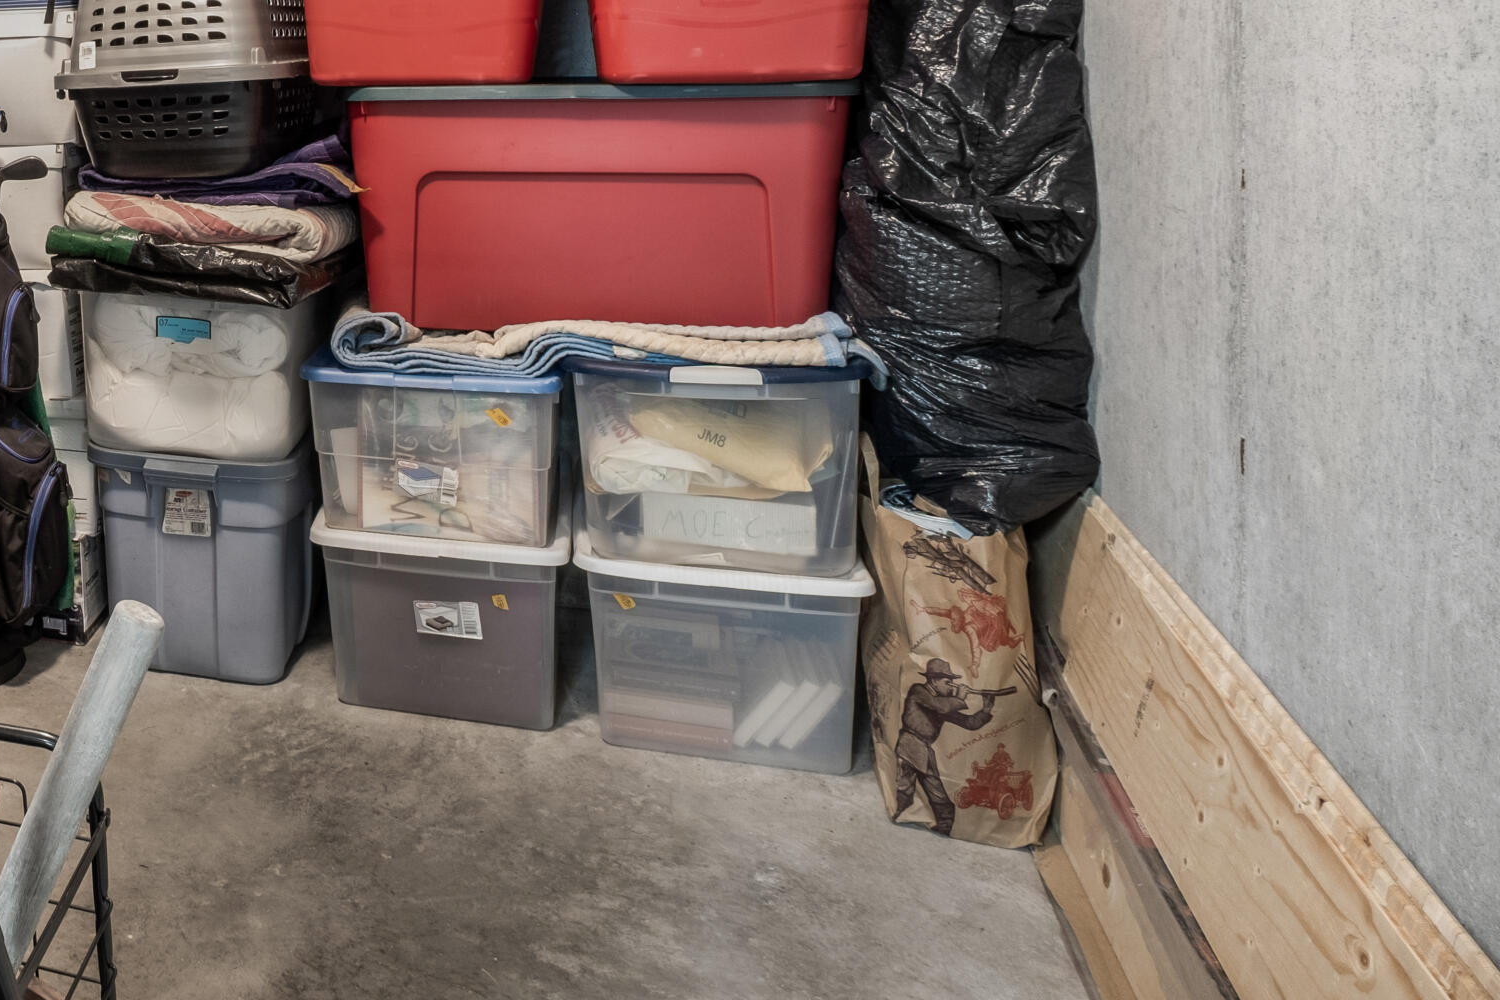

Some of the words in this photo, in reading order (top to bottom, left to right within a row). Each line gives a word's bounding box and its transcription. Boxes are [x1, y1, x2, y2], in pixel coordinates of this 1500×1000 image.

[158, 319, 169, 327] 07
[697, 428, 726, 448] JM8
[661, 509, 727, 538] MOE
